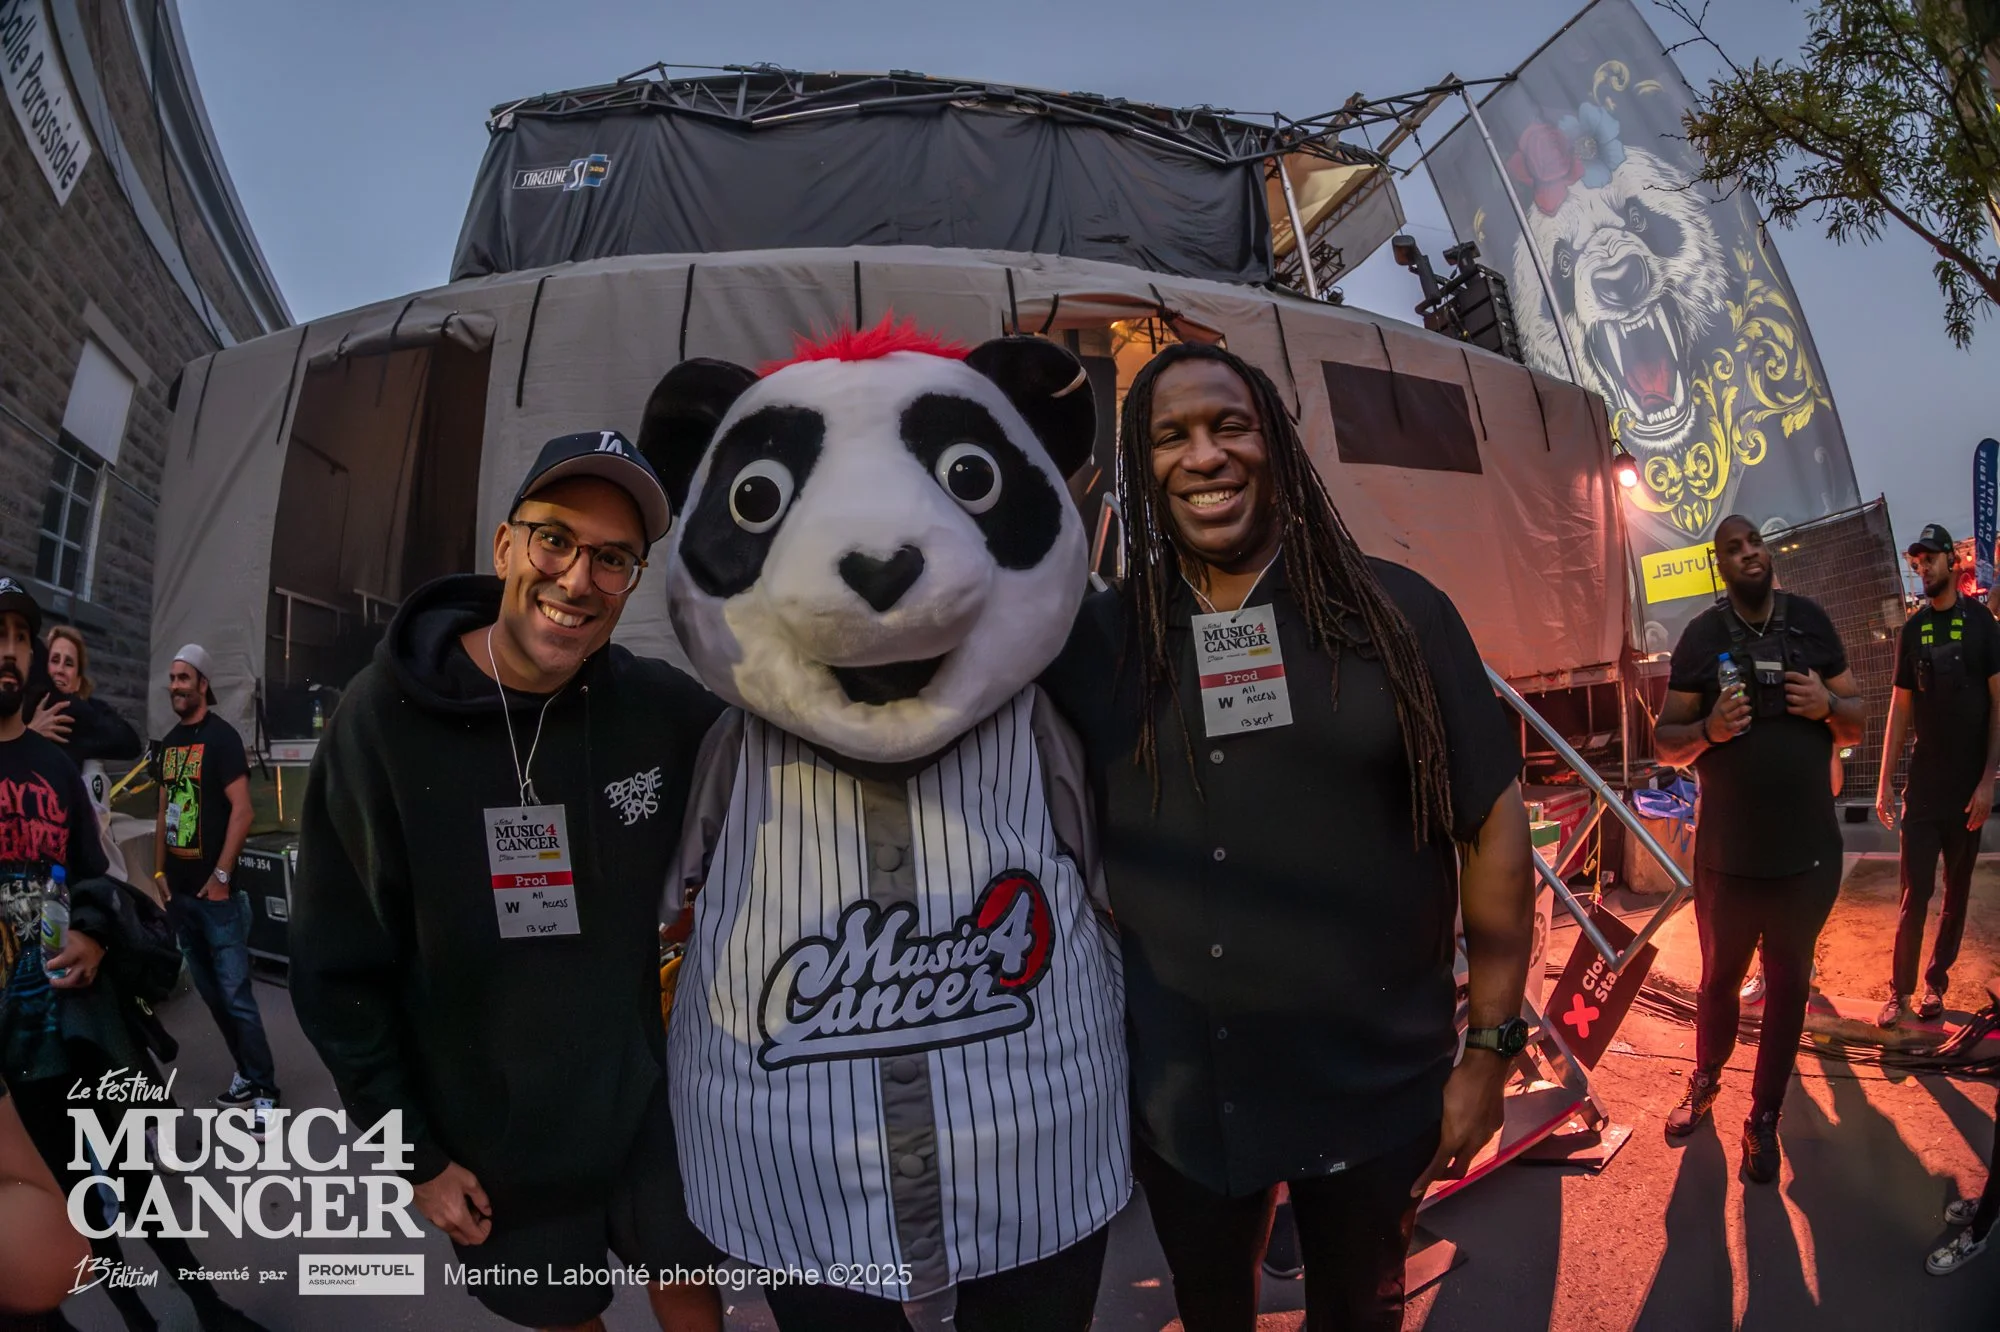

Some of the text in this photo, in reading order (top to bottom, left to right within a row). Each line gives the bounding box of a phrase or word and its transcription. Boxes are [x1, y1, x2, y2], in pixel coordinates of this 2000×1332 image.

[0, 0, 80, 190] Salle Paroissiale
[521, 168, 570, 187] STAGELINE
[594, 431, 629, 457] LA
[1978, 450, 1987, 538] DISTILLERIE
[1985, 481, 1995, 543] DU QUAI
[1203, 622, 1266, 642] MUSIC4
[1204, 634, 1270, 653] CANCER
[1225, 671, 1258, 684] Prod
[1242, 685, 1256, 694] All
[1218, 697, 1233, 709] W
[604, 766, 663, 808] BEASTIE
[620, 792, 658, 825] BOYS
[494, 824, 557, 838] MUSIC4
[496, 836, 560, 851] CANCER
[515, 875, 548, 886] Prod
[532, 891, 543, 900] All
[505, 901, 520, 913] W
[765, 945, 1026, 1046] Cancer
